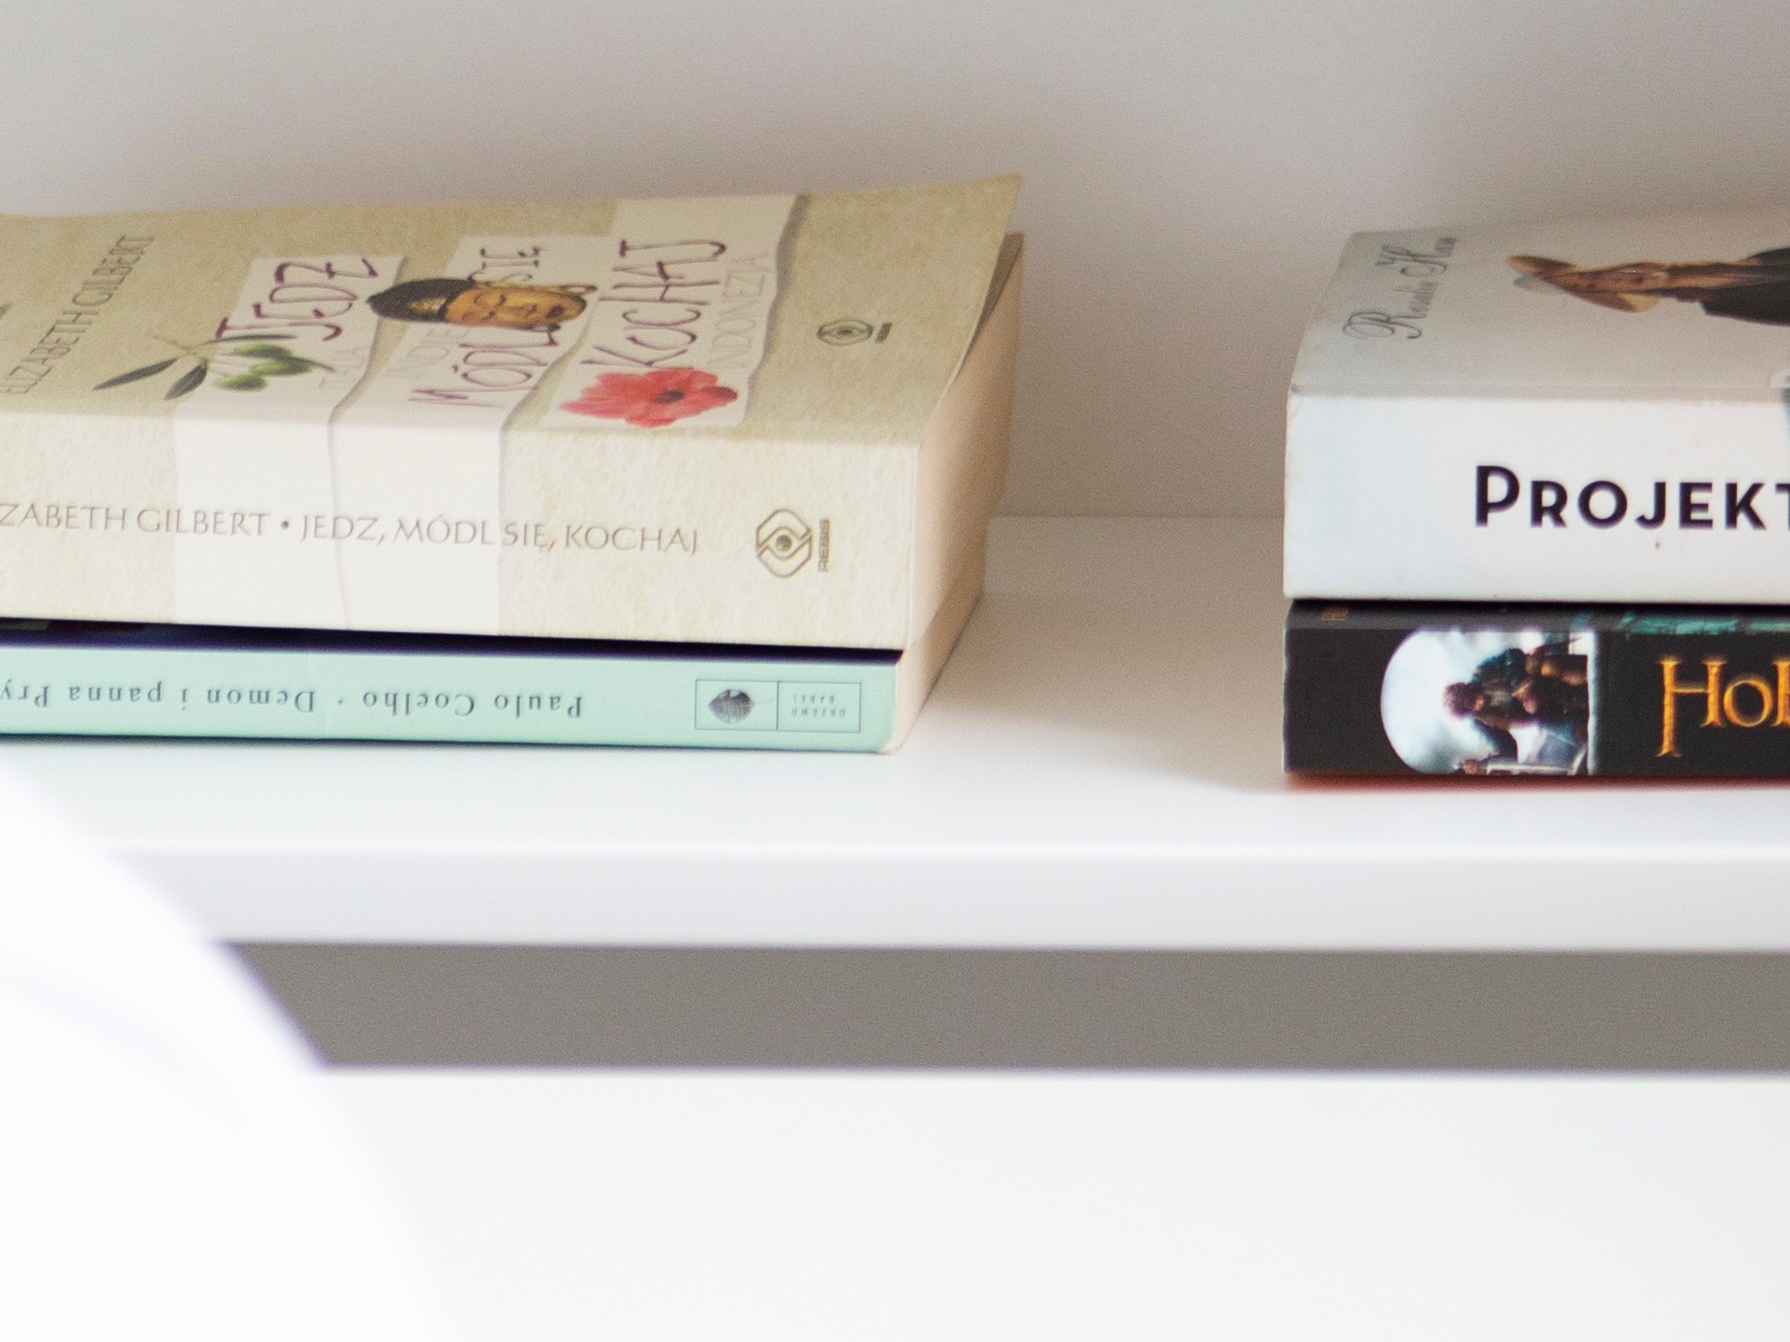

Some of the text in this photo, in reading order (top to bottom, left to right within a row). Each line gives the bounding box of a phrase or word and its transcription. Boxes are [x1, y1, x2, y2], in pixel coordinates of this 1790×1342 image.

[72, 233, 156, 307] GILBERT
[136, 507, 271, 536] GILBERT
[300, 514, 385, 546] JEDZ,
[391, 513, 495, 545] MÓDL
[502, 522, 556, 554] SIĘ,
[564, 524, 699, 557] KOCHAJ
[68, 681, 163, 704] panna
[181, 686, 189, 711] i
[206, 687, 316, 713] Demon
[362, 691, 475, 717] Coelho
[494, 694, 583, 718] Paulo
